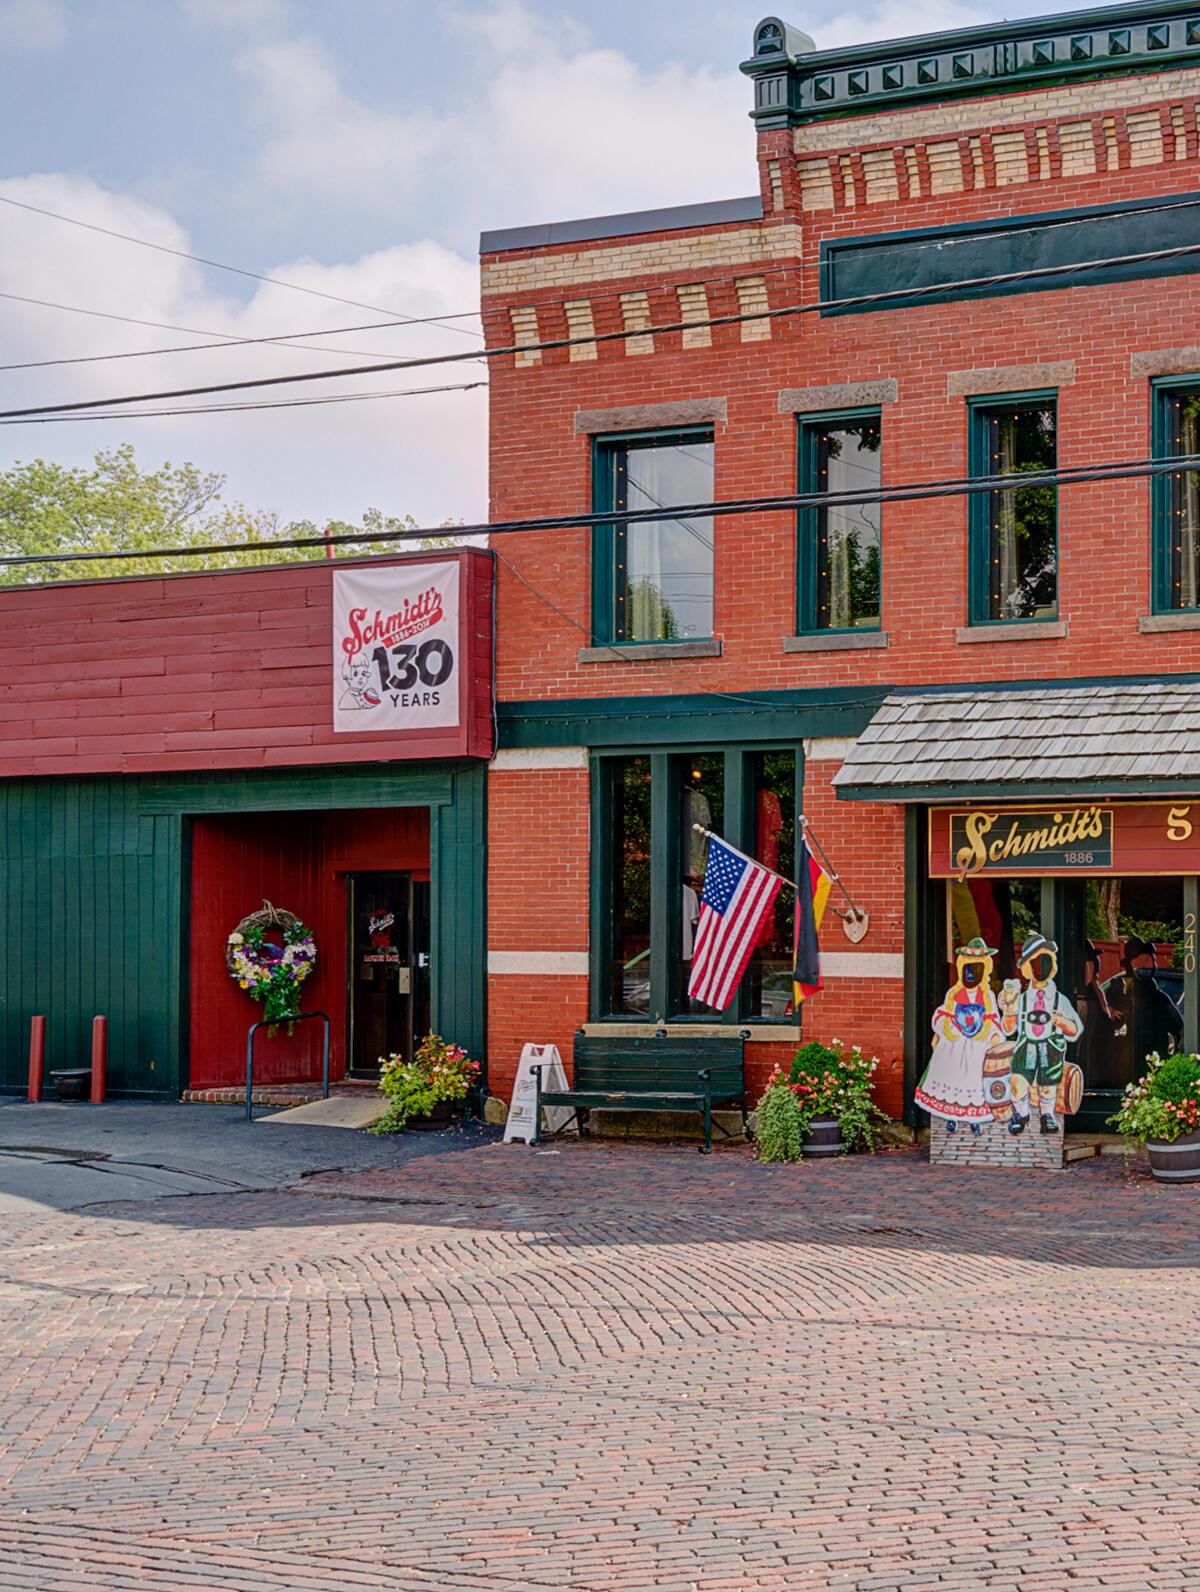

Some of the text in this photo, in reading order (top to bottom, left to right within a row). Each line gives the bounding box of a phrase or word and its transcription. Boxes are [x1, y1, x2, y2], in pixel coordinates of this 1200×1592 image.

[342, 587, 443, 666] Schmidt's
[371, 639, 454, 692] 130
[390, 691, 441, 708] YEARS
[956, 806, 1103, 883] Schmidt's
[1064, 852, 1094, 864] 1886
[1184, 912, 1196, 973] 240
